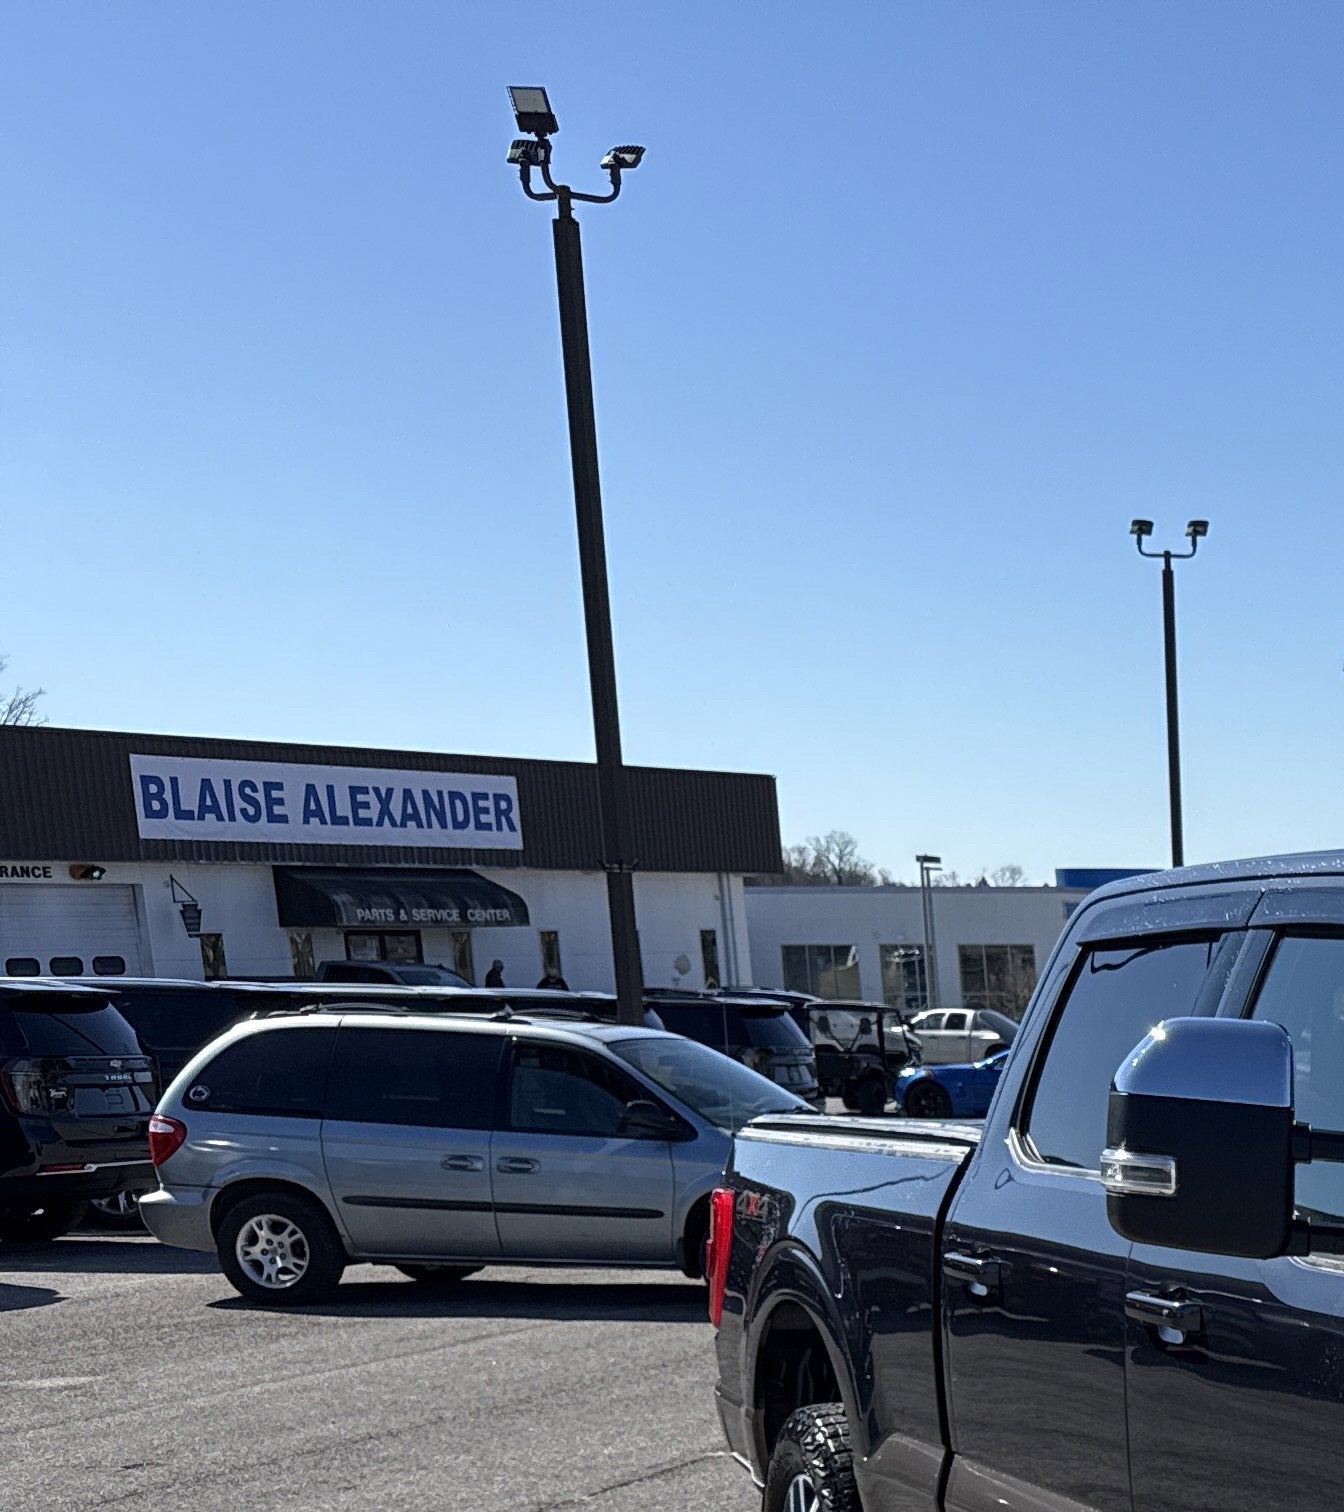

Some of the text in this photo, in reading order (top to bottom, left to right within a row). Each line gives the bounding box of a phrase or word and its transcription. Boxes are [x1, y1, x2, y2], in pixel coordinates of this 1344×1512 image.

[139, 774, 518, 833] BLAISE ALEXANDER
[0, 865, 52, 879] RANCE
[356, 909, 511, 922] PARTS & SERVICE CENTER
